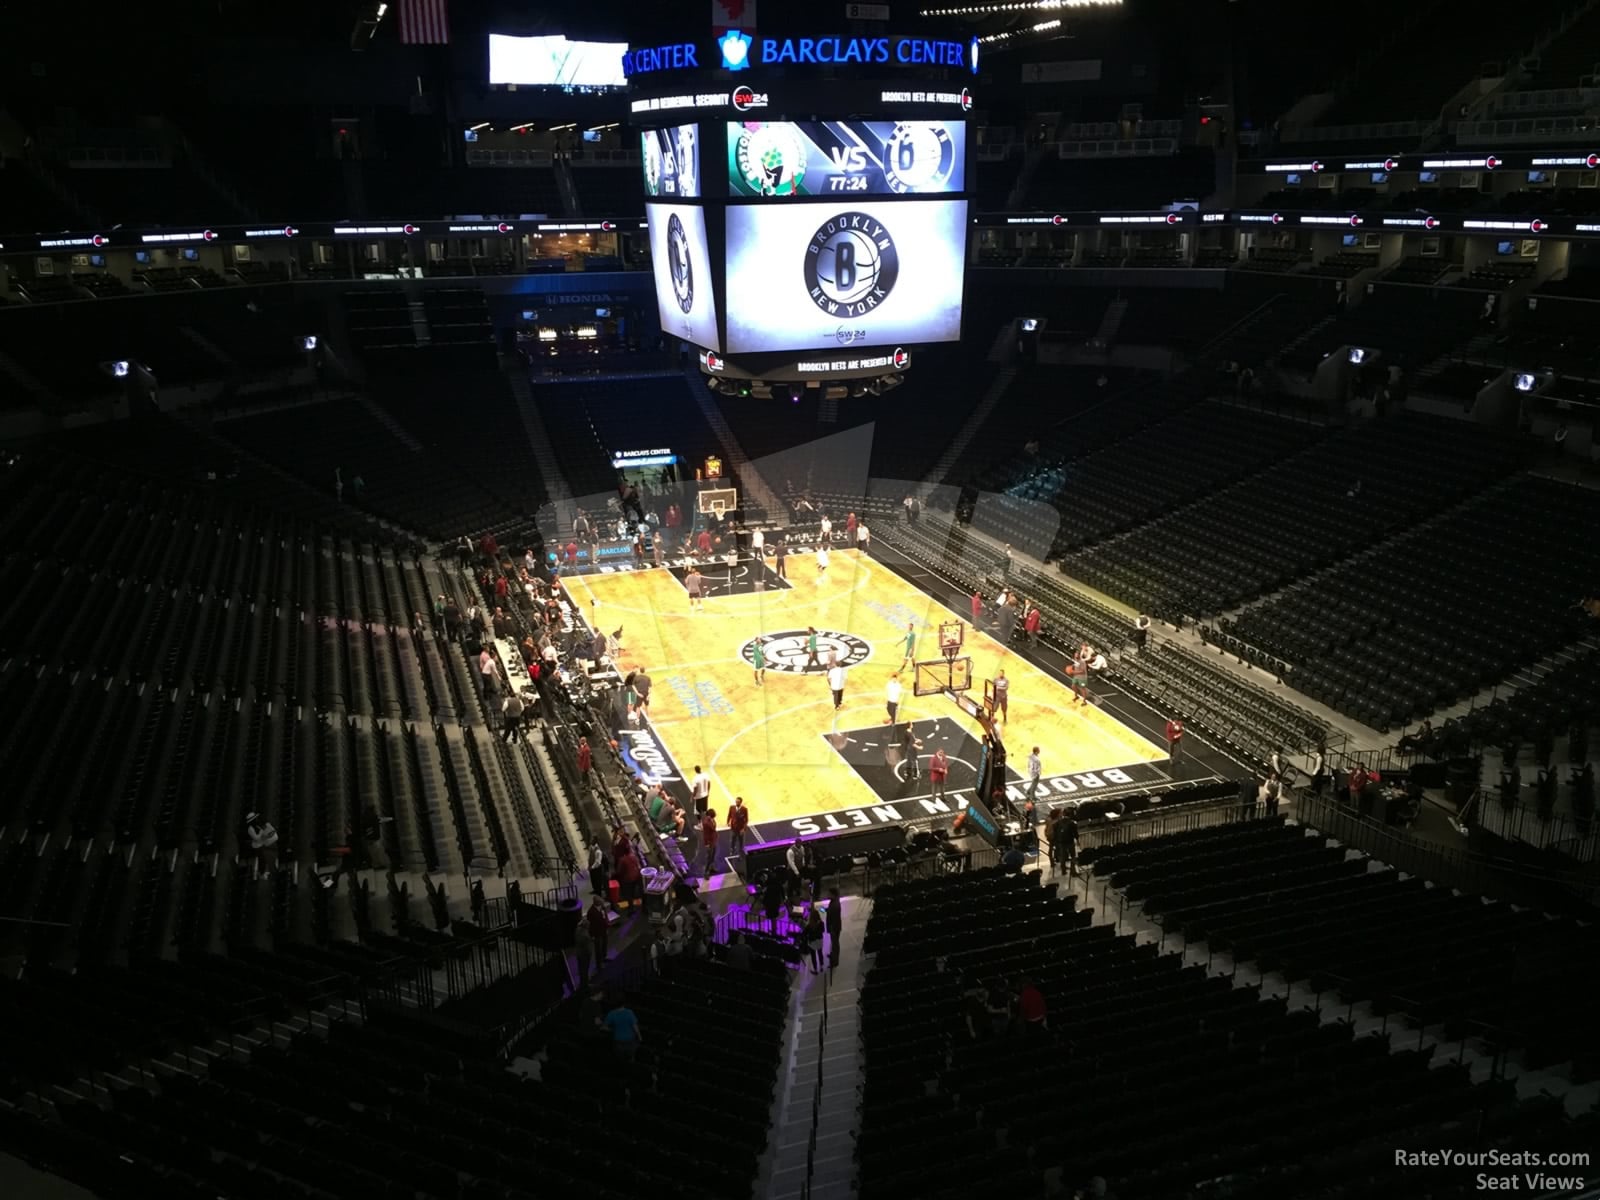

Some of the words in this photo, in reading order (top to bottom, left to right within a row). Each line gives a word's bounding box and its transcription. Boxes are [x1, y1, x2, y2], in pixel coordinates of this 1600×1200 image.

[635, 44, 699, 72] CENTER
[761, 38, 889, 64] BARCLAYS
[896, 39, 964, 66] CENTER
[831, 146, 867, 172] VS
[829, 176, 868, 191] 77:24
[809, 215, 891, 255] BROOKLYN
[559, 294, 613, 304] HONDA
[811, 286, 839, 315] NEW
[846, 286, 886, 316] YORK
[797, 362, 830, 372] BROOKLYN
[831, 361, 847, 371] NETS
[847, 360, 860, 370] ARE
[650, 448, 672, 456] CENTER
[601, 546, 631, 555] BARCLAYS
[918, 768, 1134, 814] BROOKYN
[791, 805, 903, 836] NETS
